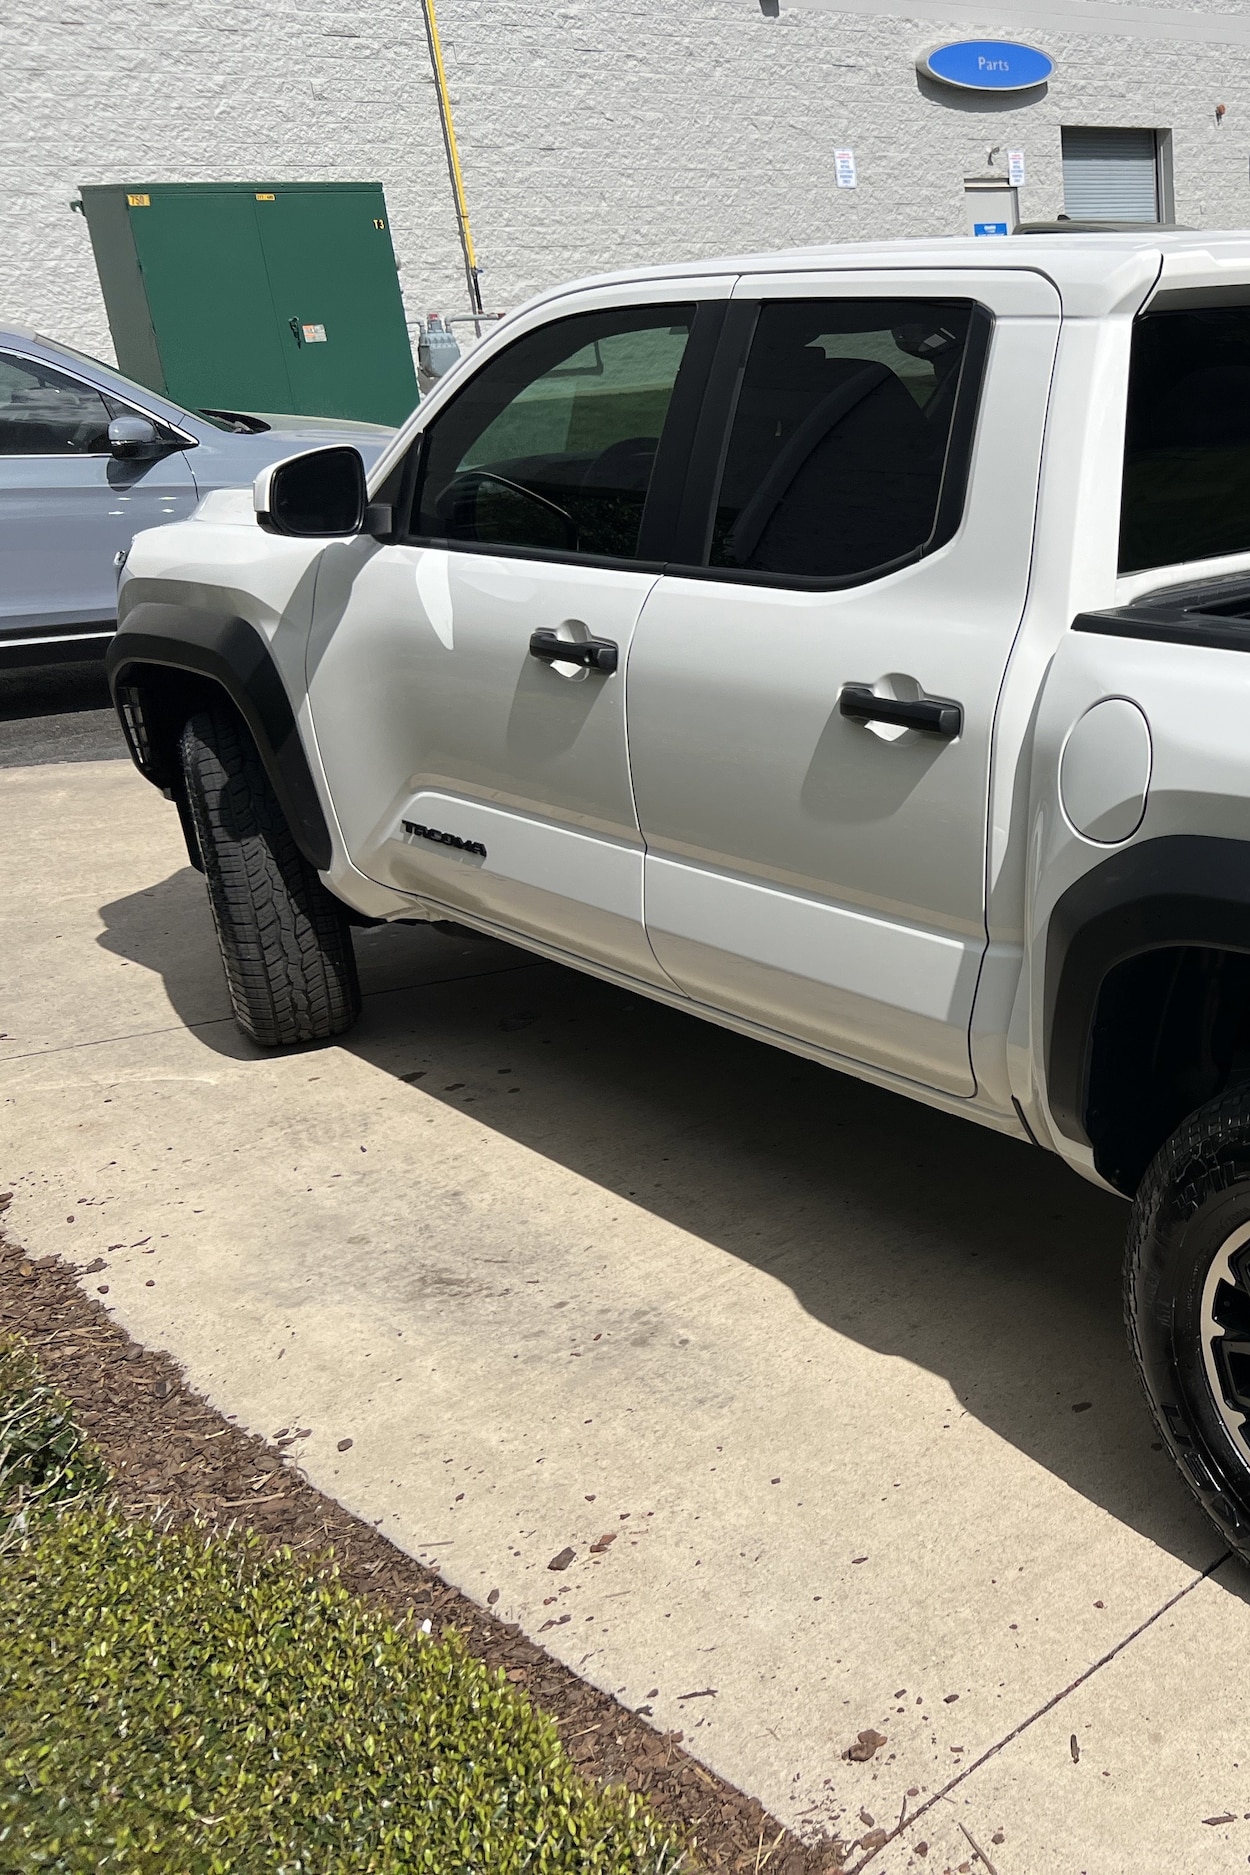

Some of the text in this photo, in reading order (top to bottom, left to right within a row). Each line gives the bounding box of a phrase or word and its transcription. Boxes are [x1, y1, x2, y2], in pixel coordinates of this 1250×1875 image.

[977, 56, 1010, 71] Parts
[373, 219, 385, 230] T3
[401, 819, 487, 857] TACOMA
